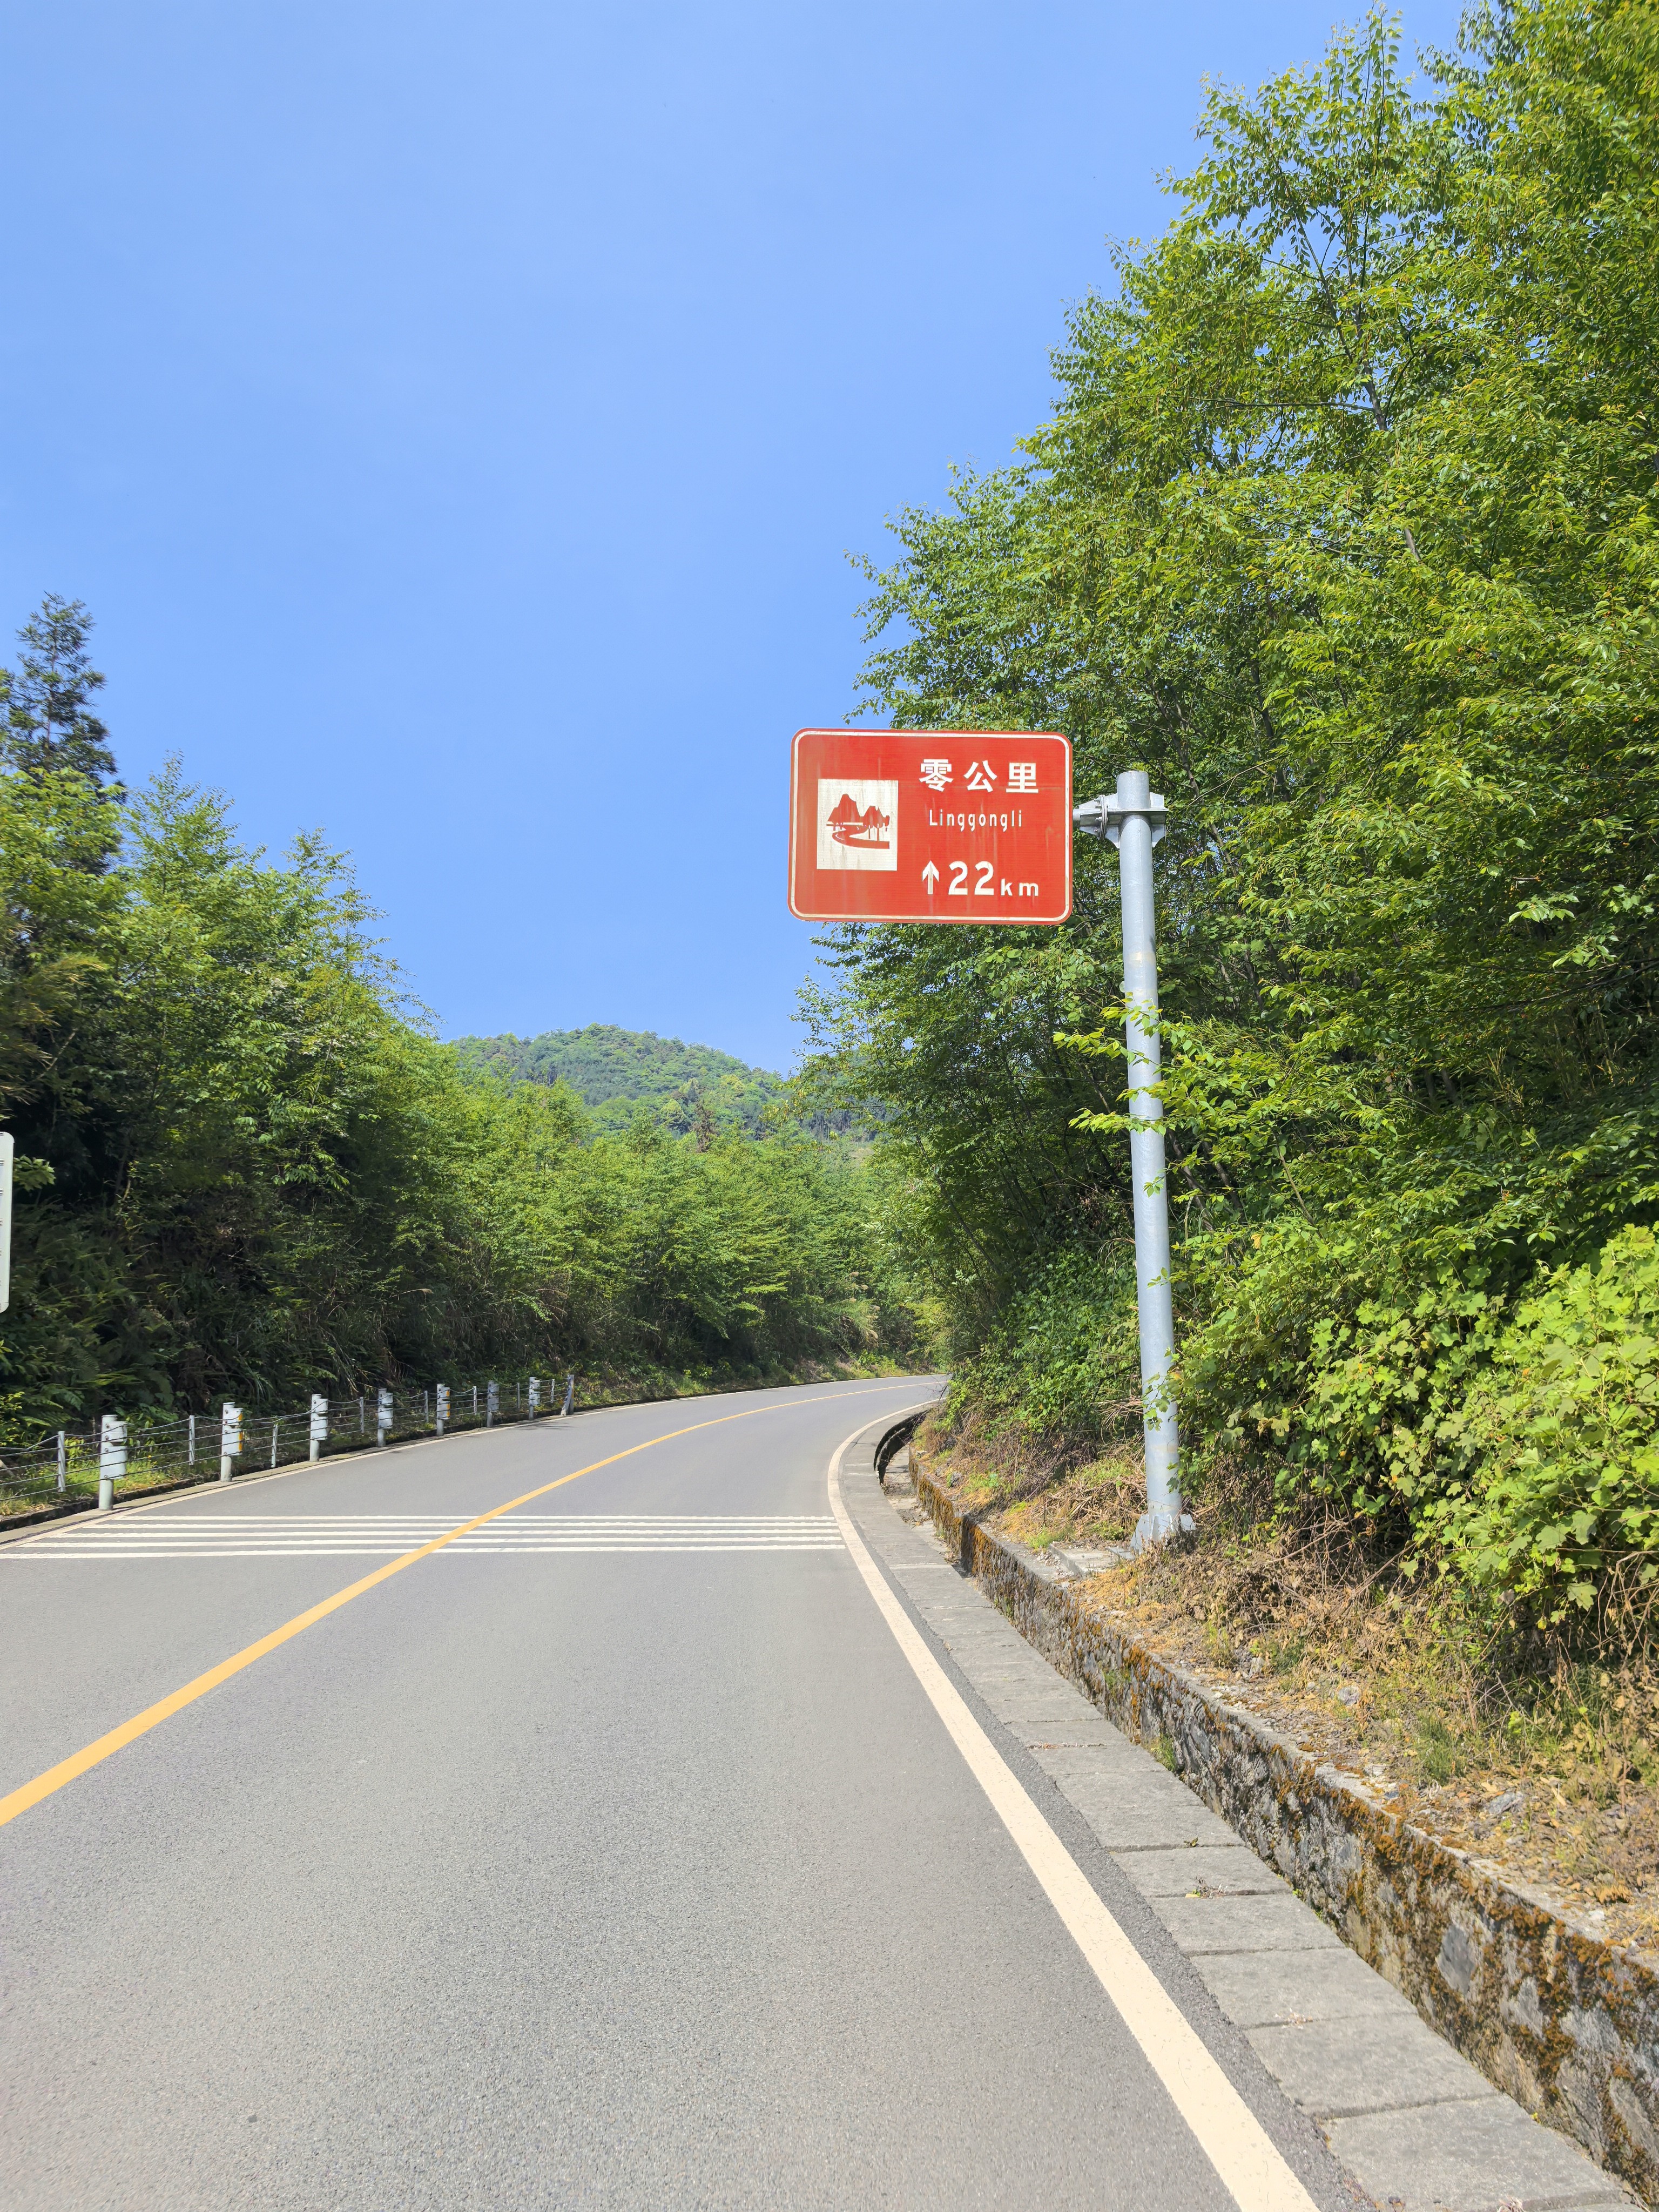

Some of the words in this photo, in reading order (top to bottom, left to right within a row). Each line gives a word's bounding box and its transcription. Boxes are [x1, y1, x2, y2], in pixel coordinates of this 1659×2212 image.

[919, 759, 1039, 793] 零公里
[929, 809, 1023, 832] Linggongli
